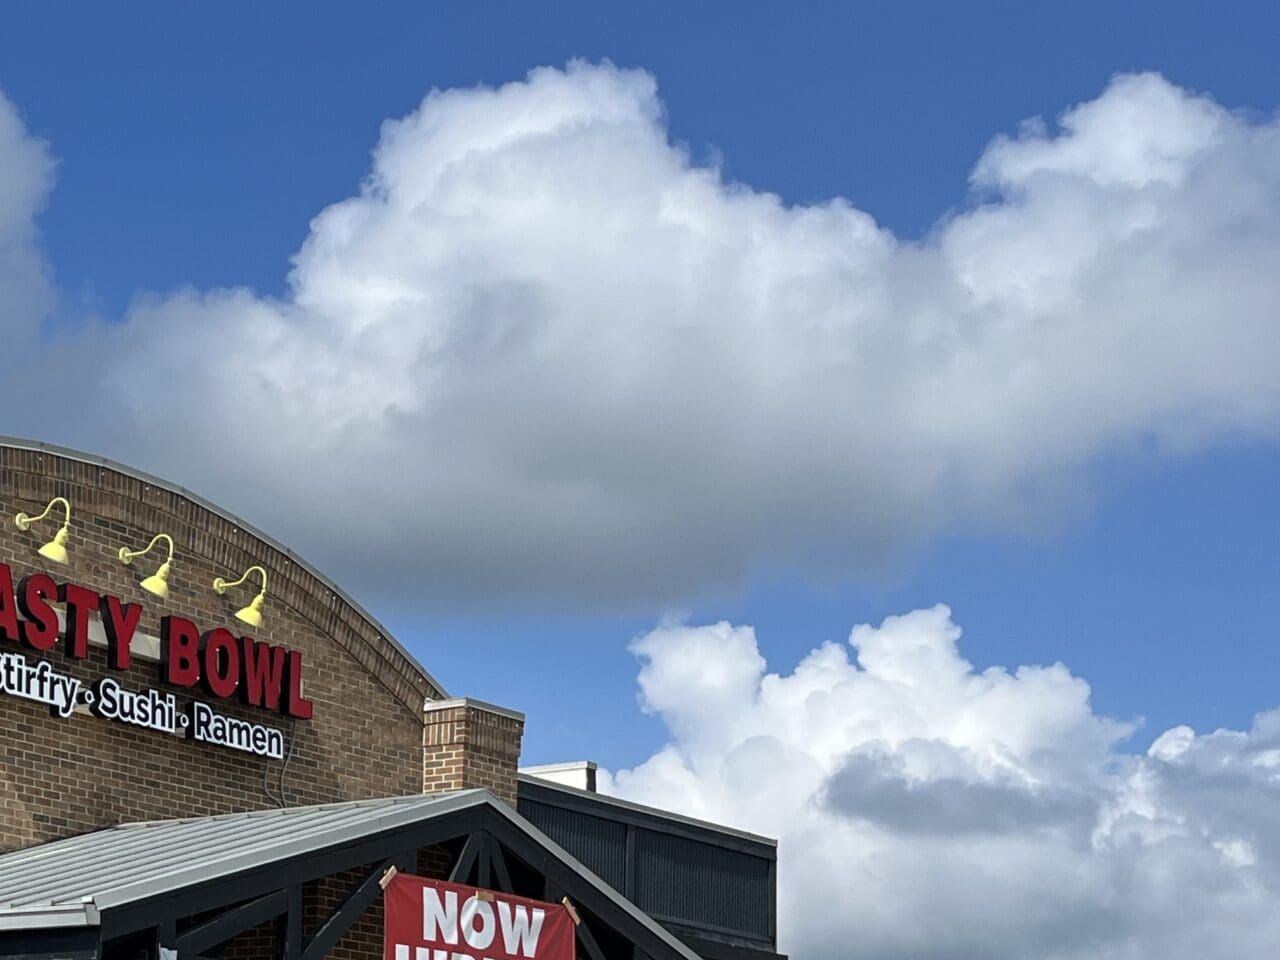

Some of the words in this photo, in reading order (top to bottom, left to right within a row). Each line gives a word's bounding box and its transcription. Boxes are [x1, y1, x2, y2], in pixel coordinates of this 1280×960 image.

[165, 615, 313, 719] BOWL
[98, 677, 177, 733] Sushi
[194, 701, 284, 760] Ramen
[422, 886, 545, 958] NOW
